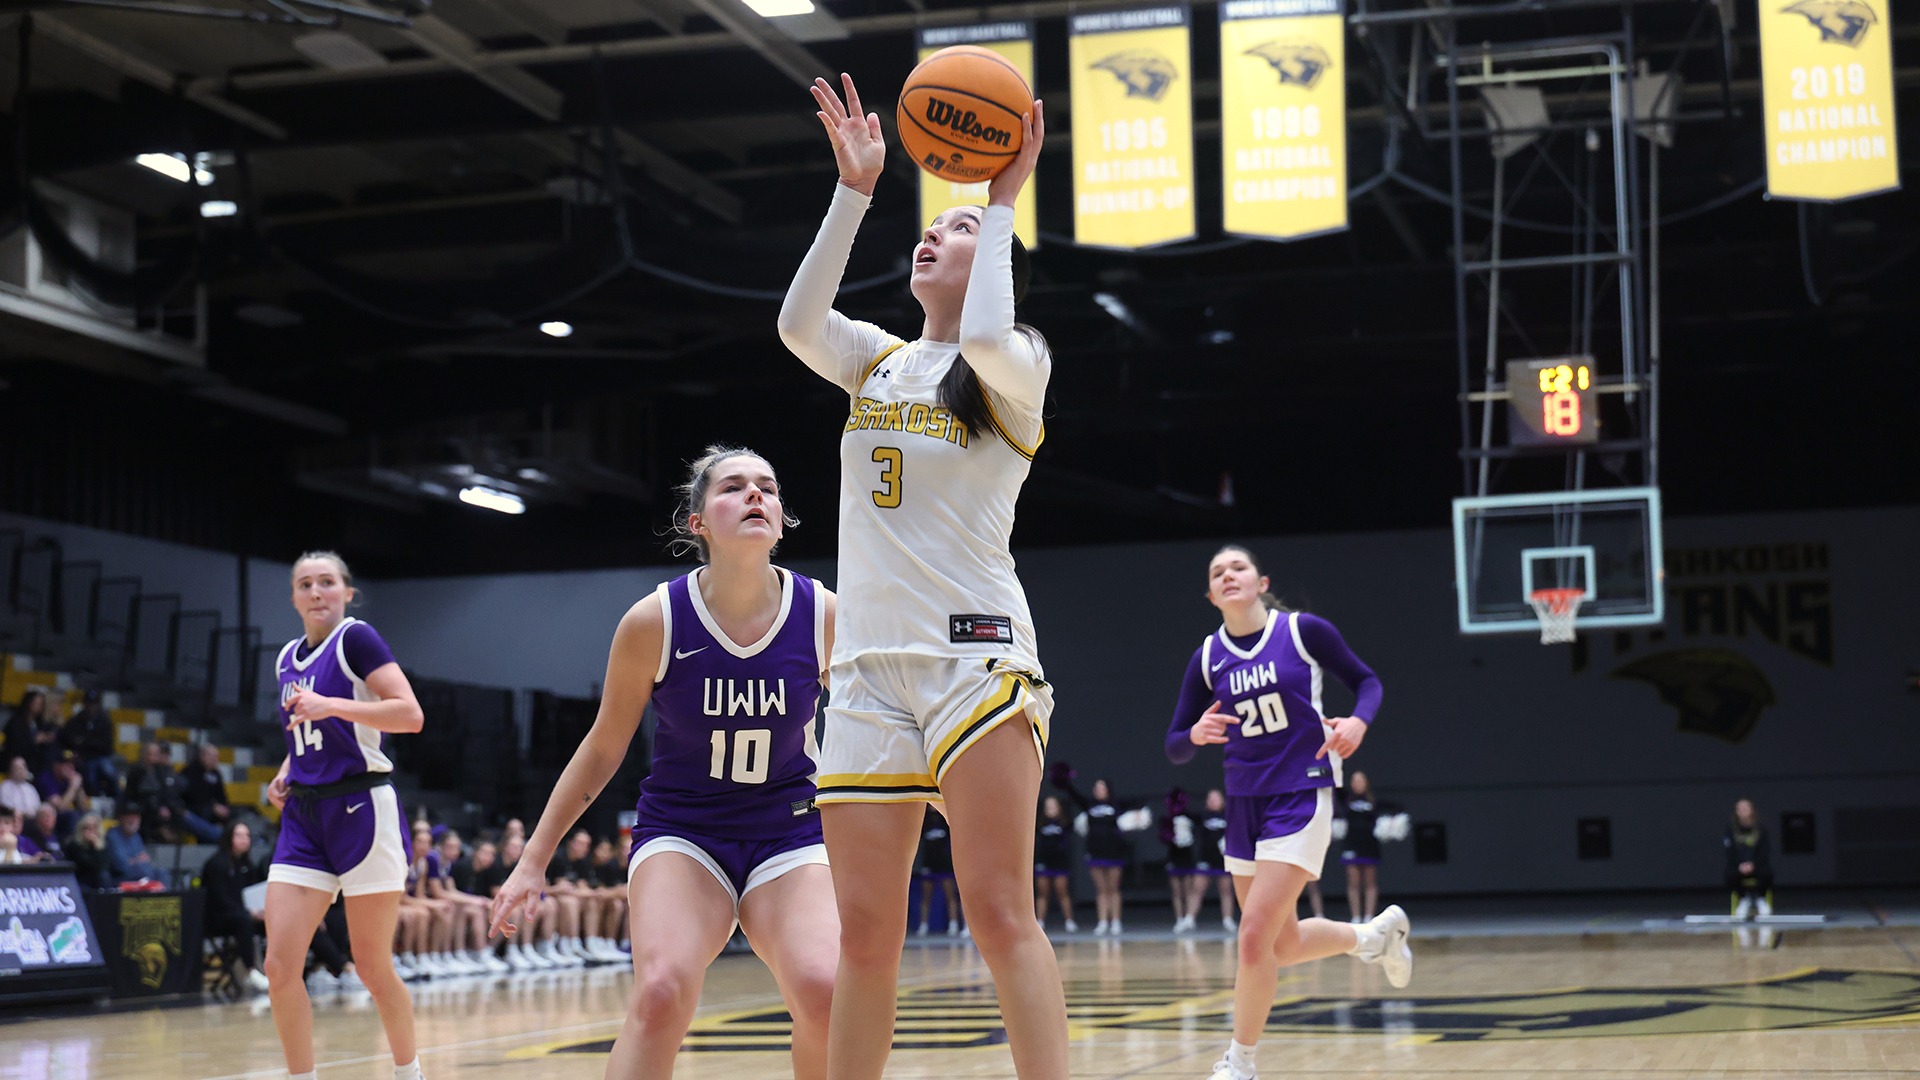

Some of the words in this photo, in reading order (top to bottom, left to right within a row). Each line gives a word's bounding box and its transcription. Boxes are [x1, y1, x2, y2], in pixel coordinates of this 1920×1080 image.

[1790, 63, 1865, 100] 2019
[926, 96, 1011, 147] Wilson
[1100, 117, 1168, 152] 1995
[1252, 105, 1319, 140] 1996
[1778, 103, 1882, 133] NATIONAL
[1235, 145, 1331, 171] NATIONAL
[1776, 135, 1887, 166] CHAMPION
[1085, 156, 1179, 183] NATIONAL
[1078, 186, 1188, 215] RUNNER-UP
[1233, 176, 1336, 204] CHAMPION
[845, 397, 969, 449] SHKOSH
[1543, 390, 1581, 436] 18
[872, 446, 904, 509] 3
[1230, 660, 1278, 696] UWW
[703, 677, 787, 717] UWW
[1234, 692, 1289, 737] 20
[289, 713, 324, 757] 14
[709, 728, 772, 785] 10
